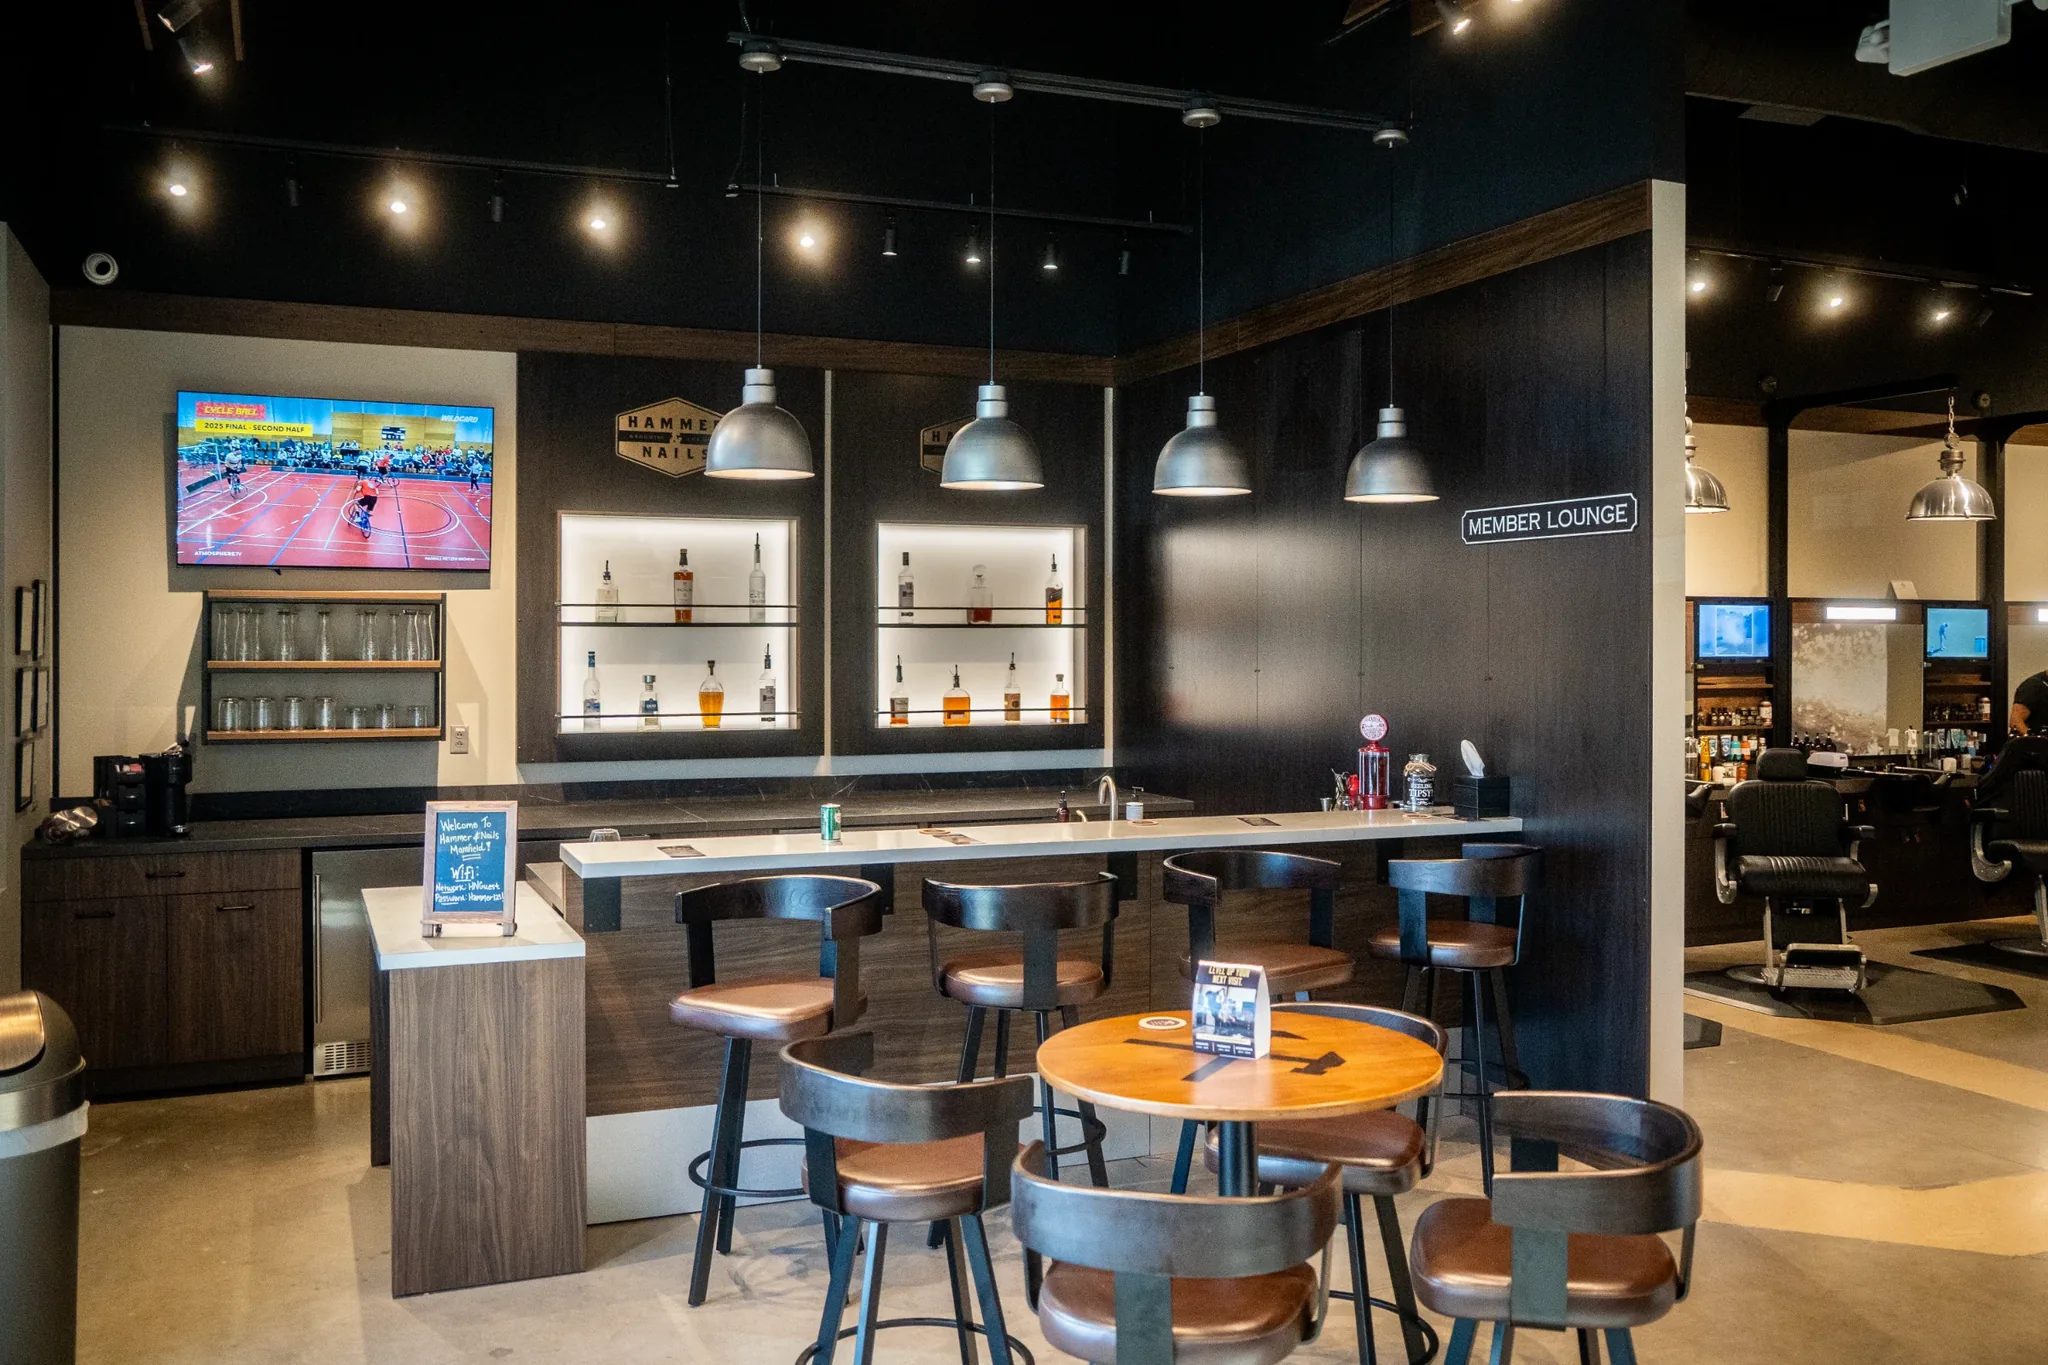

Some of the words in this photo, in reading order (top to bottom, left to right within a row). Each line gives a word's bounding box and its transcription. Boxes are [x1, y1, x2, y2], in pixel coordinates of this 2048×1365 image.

[204, 406, 233, 415] CYCLE
[235, 407, 258, 416] BALL
[441, 414, 479, 423] WILDCARD
[1469, 512, 1541, 536] MEMBER
[1547, 502, 1628, 529] LOUNGE
[440, 818, 478, 831] Welcome
[481, 816, 492, 828] To
[440, 832, 472, 845] Hammer
[480, 830, 500, 841] Nails
[1208, 966, 1225, 975] LEVEL
[1226, 967, 1236, 976] UP
[1212, 975, 1227, 985] NEXT
